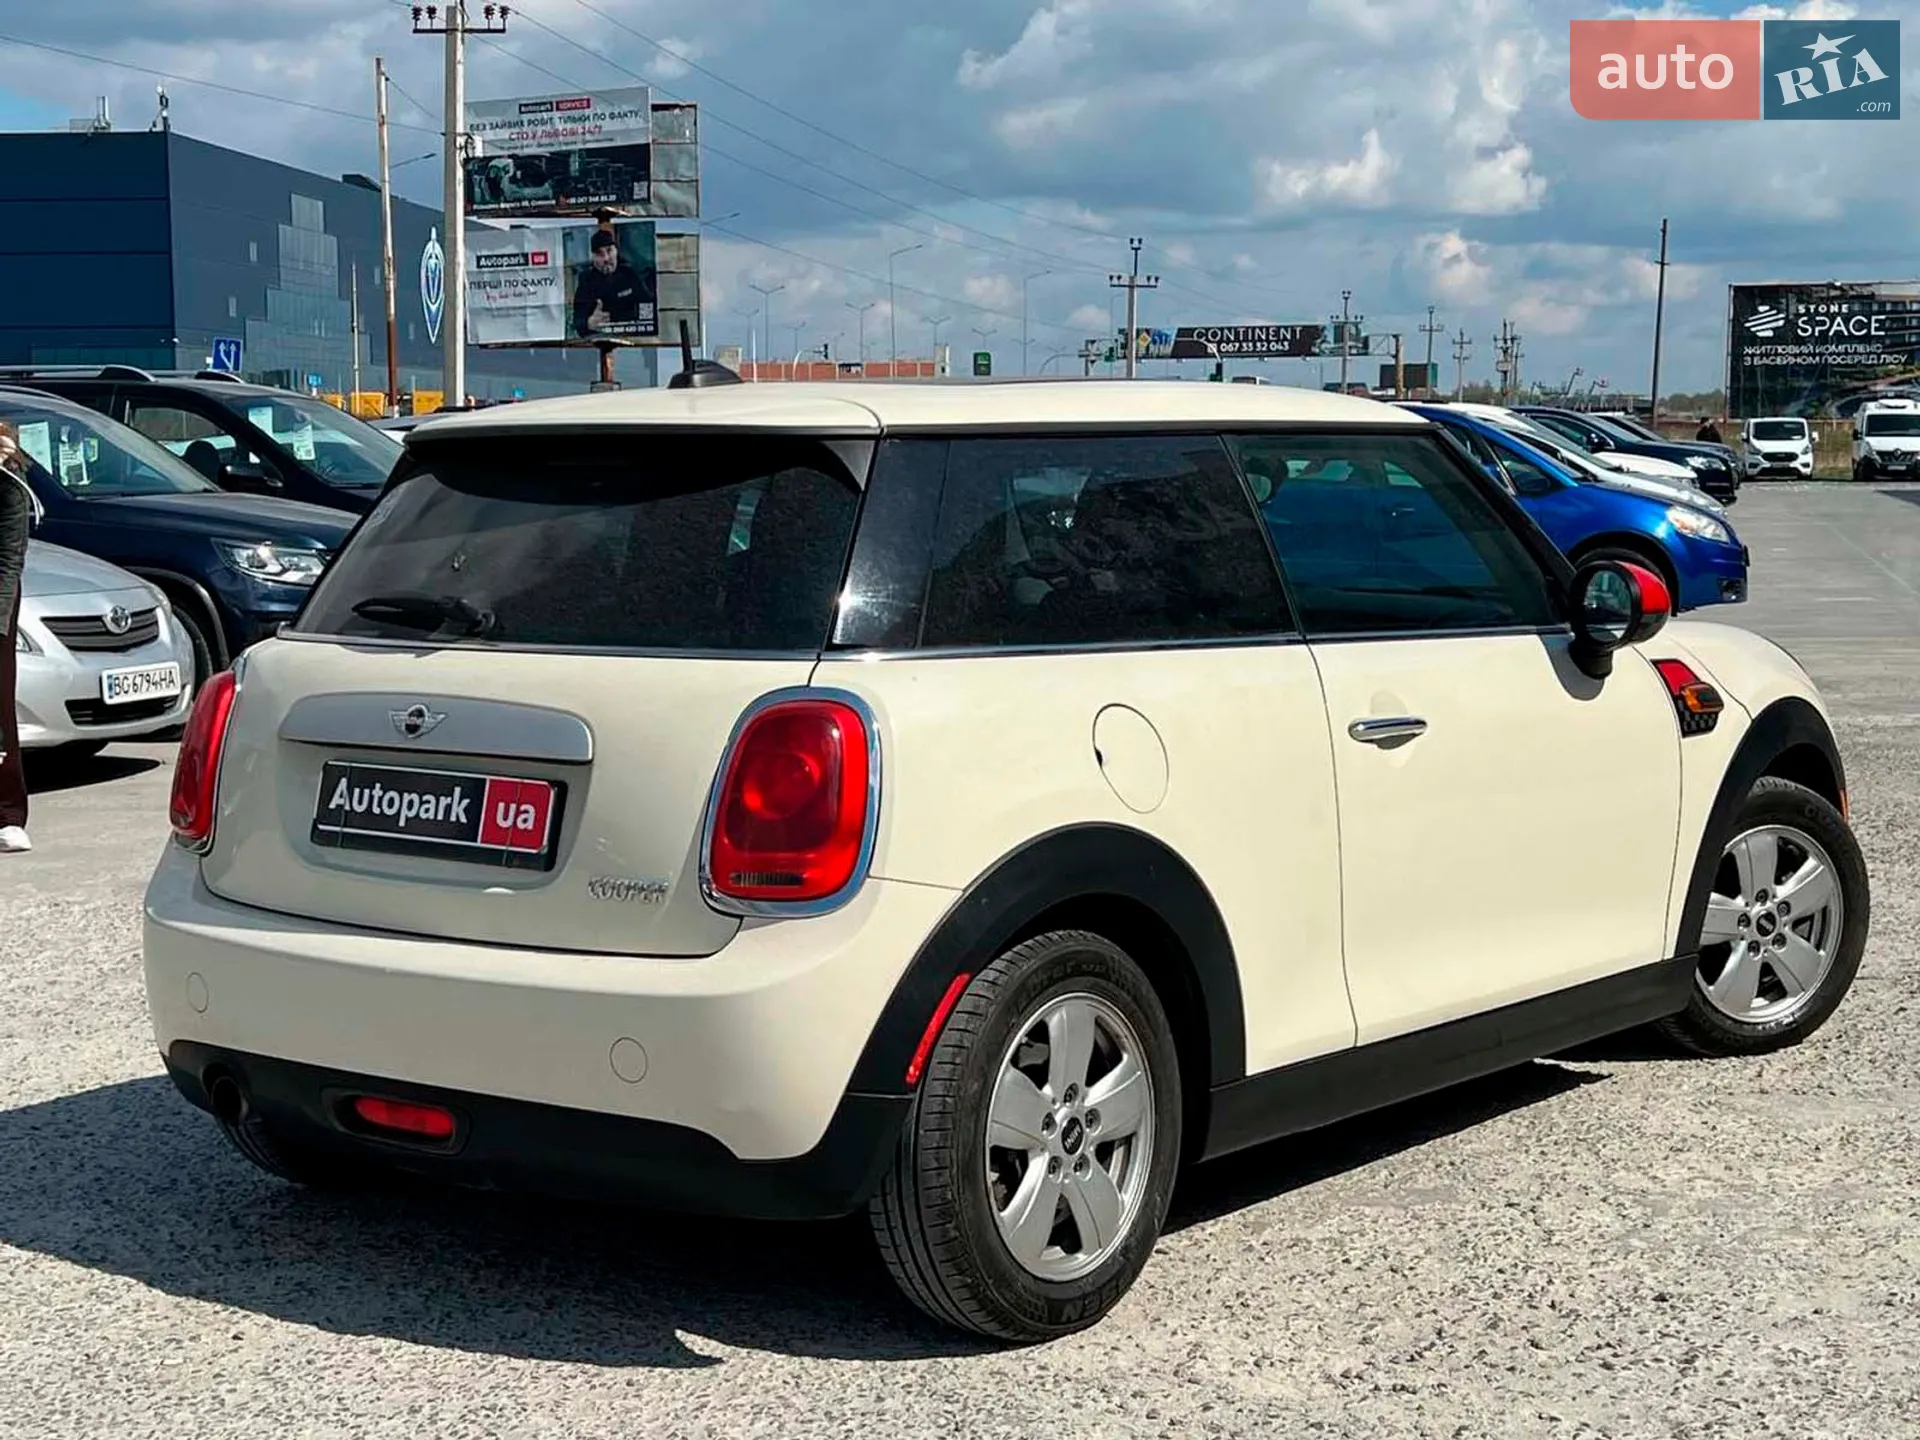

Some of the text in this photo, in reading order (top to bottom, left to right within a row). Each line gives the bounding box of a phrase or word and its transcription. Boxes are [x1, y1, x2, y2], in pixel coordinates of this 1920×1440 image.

[480, 256, 527, 268] Autopark
[470, 280, 502, 289] ПЕРШІ
[504, 279, 519, 288] ПО
[1797, 303, 1849, 313] STONE
[1797, 315, 1886, 337] SPACE
[1193, 327, 1302, 341] CONTINENT
[1220, 342, 1239, 352] 067
[1743, 343, 1814, 354] ЖИТЛОВИЙ
[1753, 354, 1820, 366] БАСЕЙНОМ
[1880, 354, 1908, 364] ЛІСУ
[328, 777, 535, 831] Autopark ua
